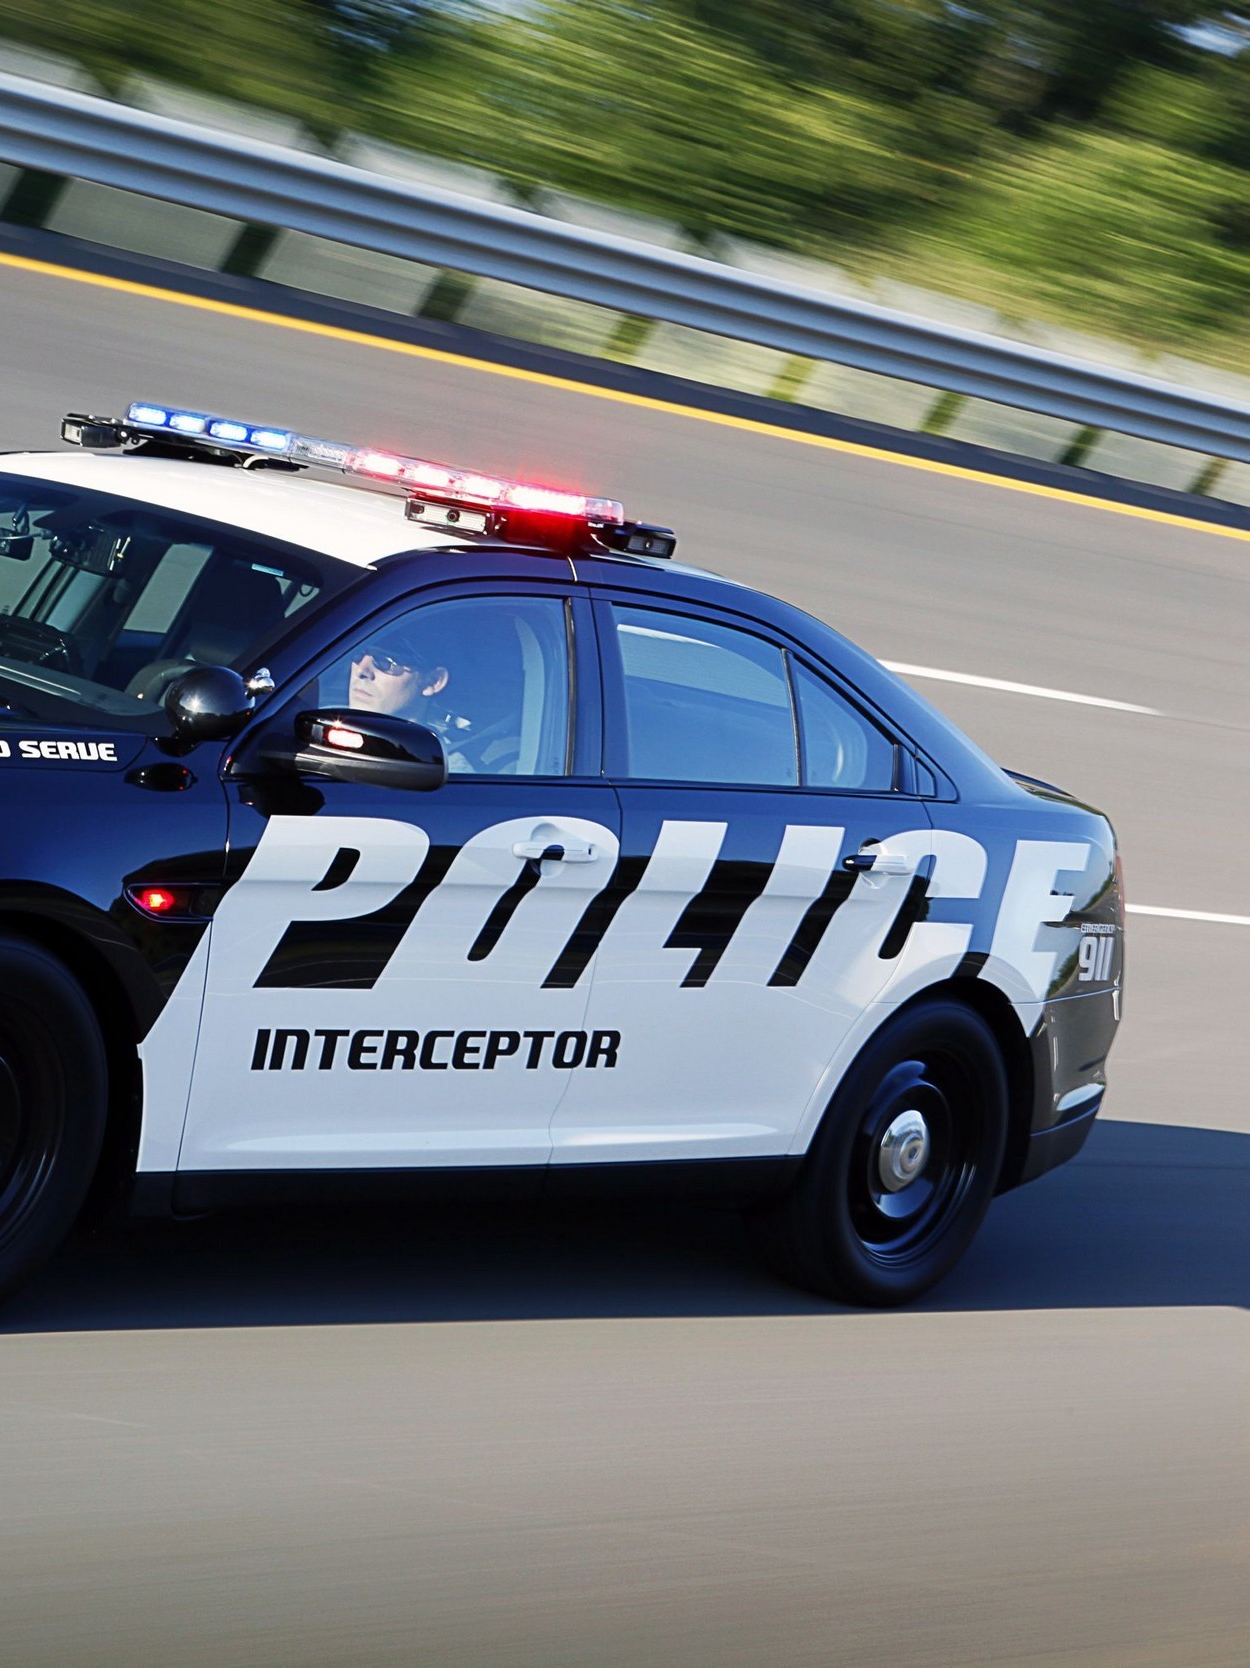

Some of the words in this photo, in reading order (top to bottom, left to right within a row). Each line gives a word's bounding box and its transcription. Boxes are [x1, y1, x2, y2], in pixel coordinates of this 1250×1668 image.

[174, 814, 1091, 992] POLICE
[1078, 936, 1115, 982] 911
[250, 1028, 621, 1070] INTERCEPTOR
